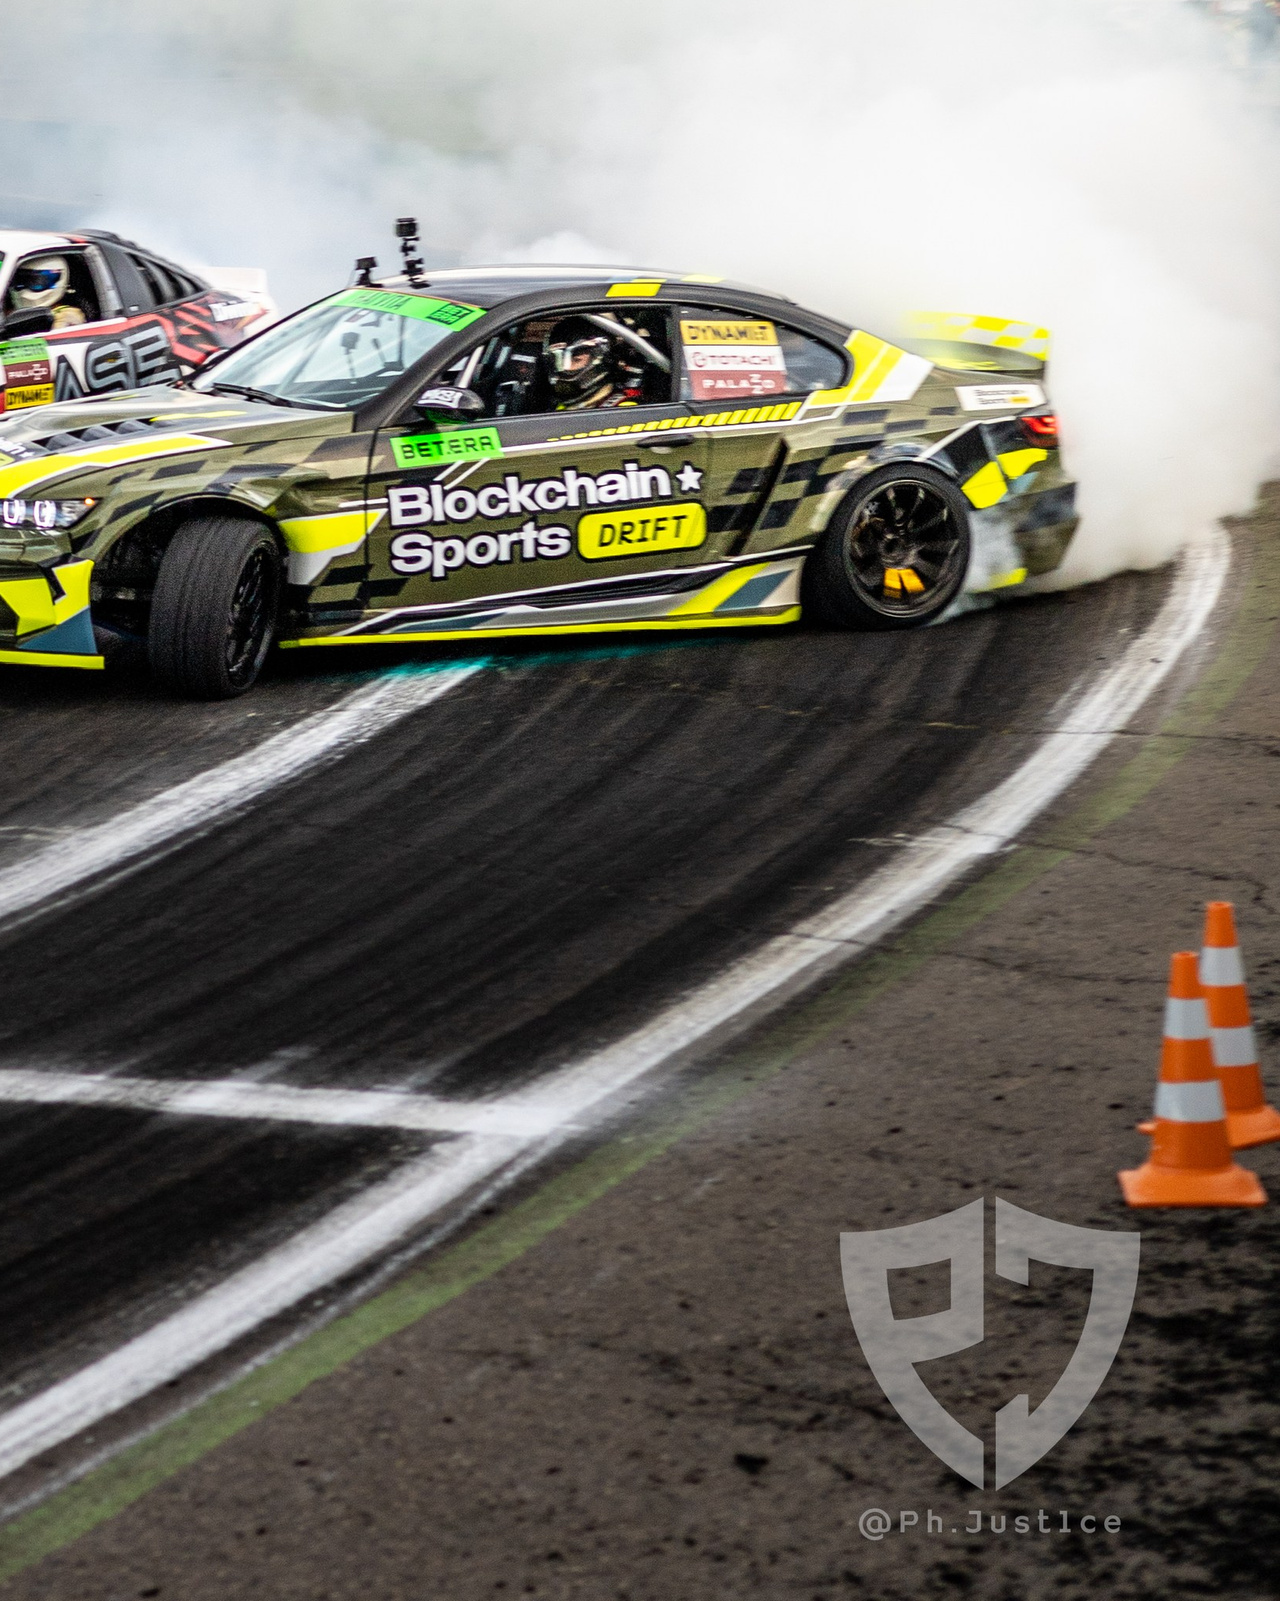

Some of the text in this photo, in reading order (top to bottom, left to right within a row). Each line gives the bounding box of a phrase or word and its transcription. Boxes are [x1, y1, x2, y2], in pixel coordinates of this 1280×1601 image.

[388, 462, 672, 526] Blockchain
[391, 515, 688, 578] Sports DRIFT
